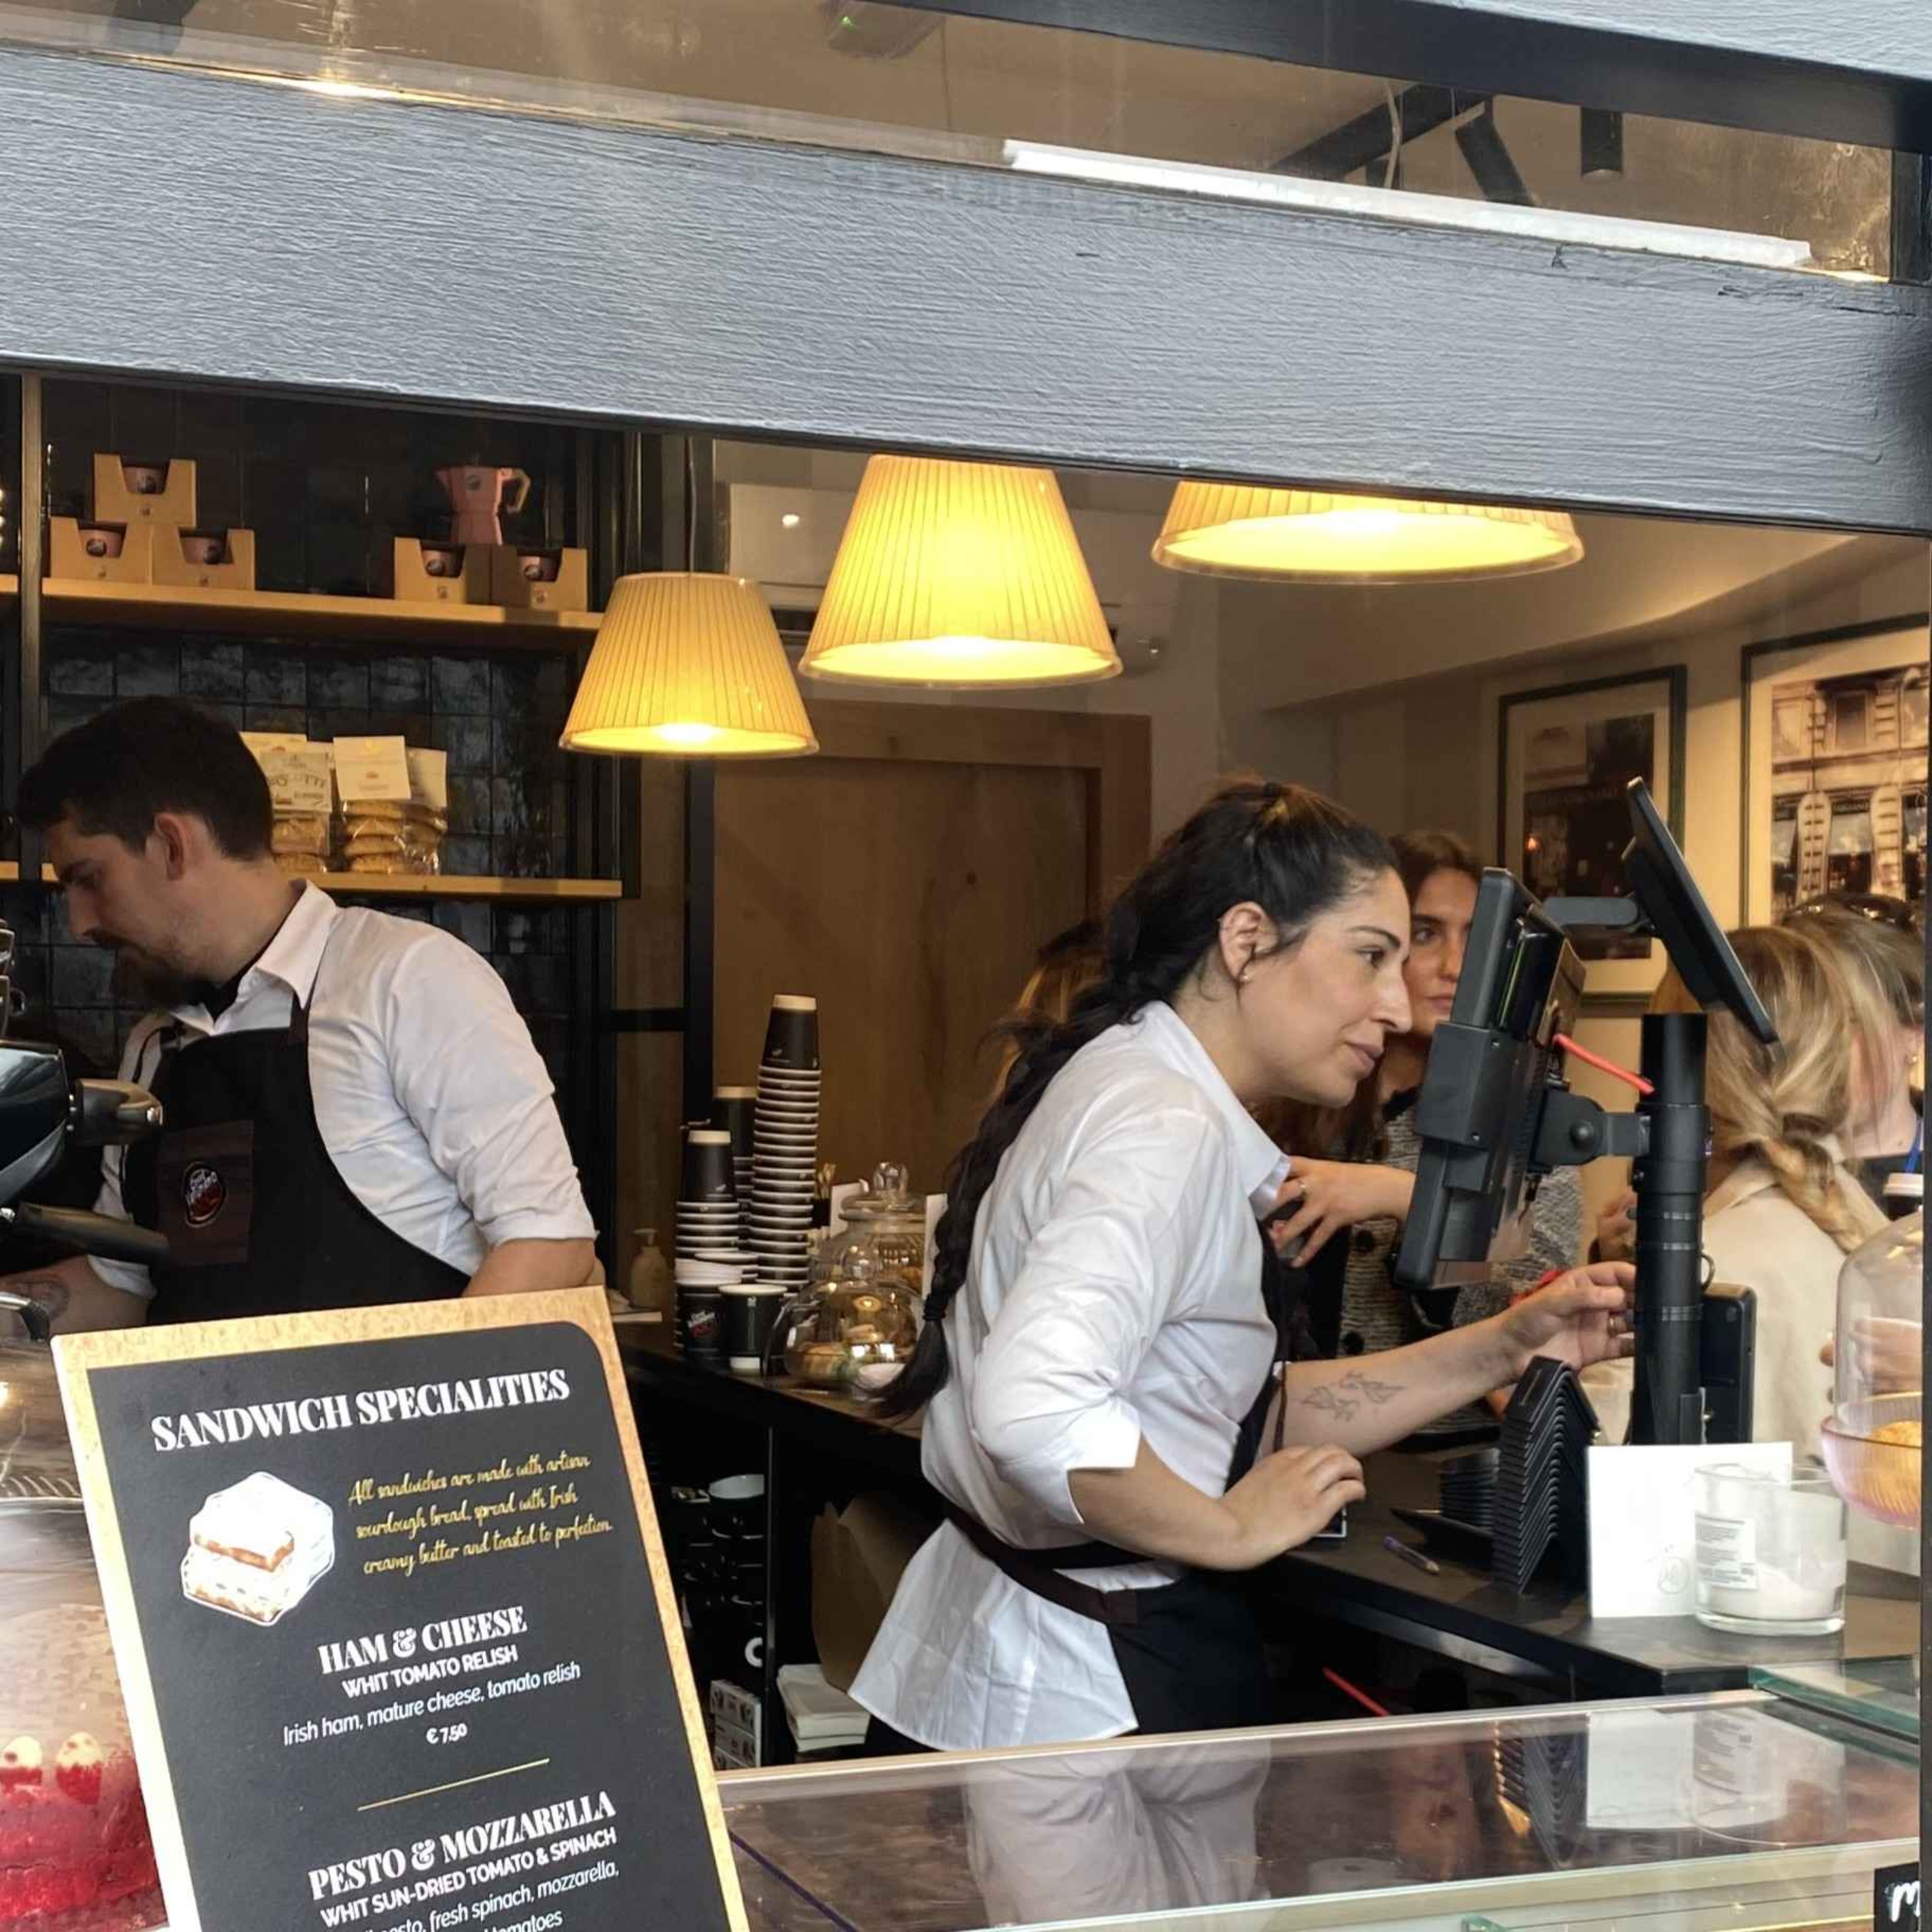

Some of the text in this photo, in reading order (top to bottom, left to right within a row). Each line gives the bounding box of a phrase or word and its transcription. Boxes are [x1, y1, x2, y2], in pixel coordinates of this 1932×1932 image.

[151, 1369, 570, 1451] SANDWICH SPECIALITIES
[348, 1450, 591, 1506] All sandwiches are made with artisan
[355, 1507, 426, 1540] sourdough
[475, 1492, 515, 1527] spread
[519, 1488, 547, 1510] with
[549, 1483, 578, 1509] Irish
[364, 1553, 415, 1577] creamy
[419, 1540, 459, 1564] butter
[462, 1531, 490, 1555] and
[492, 1523, 536, 1551] toasted
[539, 1524, 551, 1542] to
[317, 1606, 527, 1674] HAM & CHEESE
[342, 1644, 519, 1698] WHIT TOMATO RELISH
[283, 1662, 580, 1745] Irish ham, mature cheese, tomato relish
[308, 1790, 616, 1900] PESTO & MOZZARELLA
[320, 1827, 617, 1928] WHIT SUN-DRIED TOMATO & SPINACH
[430, 1904, 468, 1932] fresh
[471, 1885, 535, 1923] spinach,
[537, 1860, 620, 1899] mozzarella,
